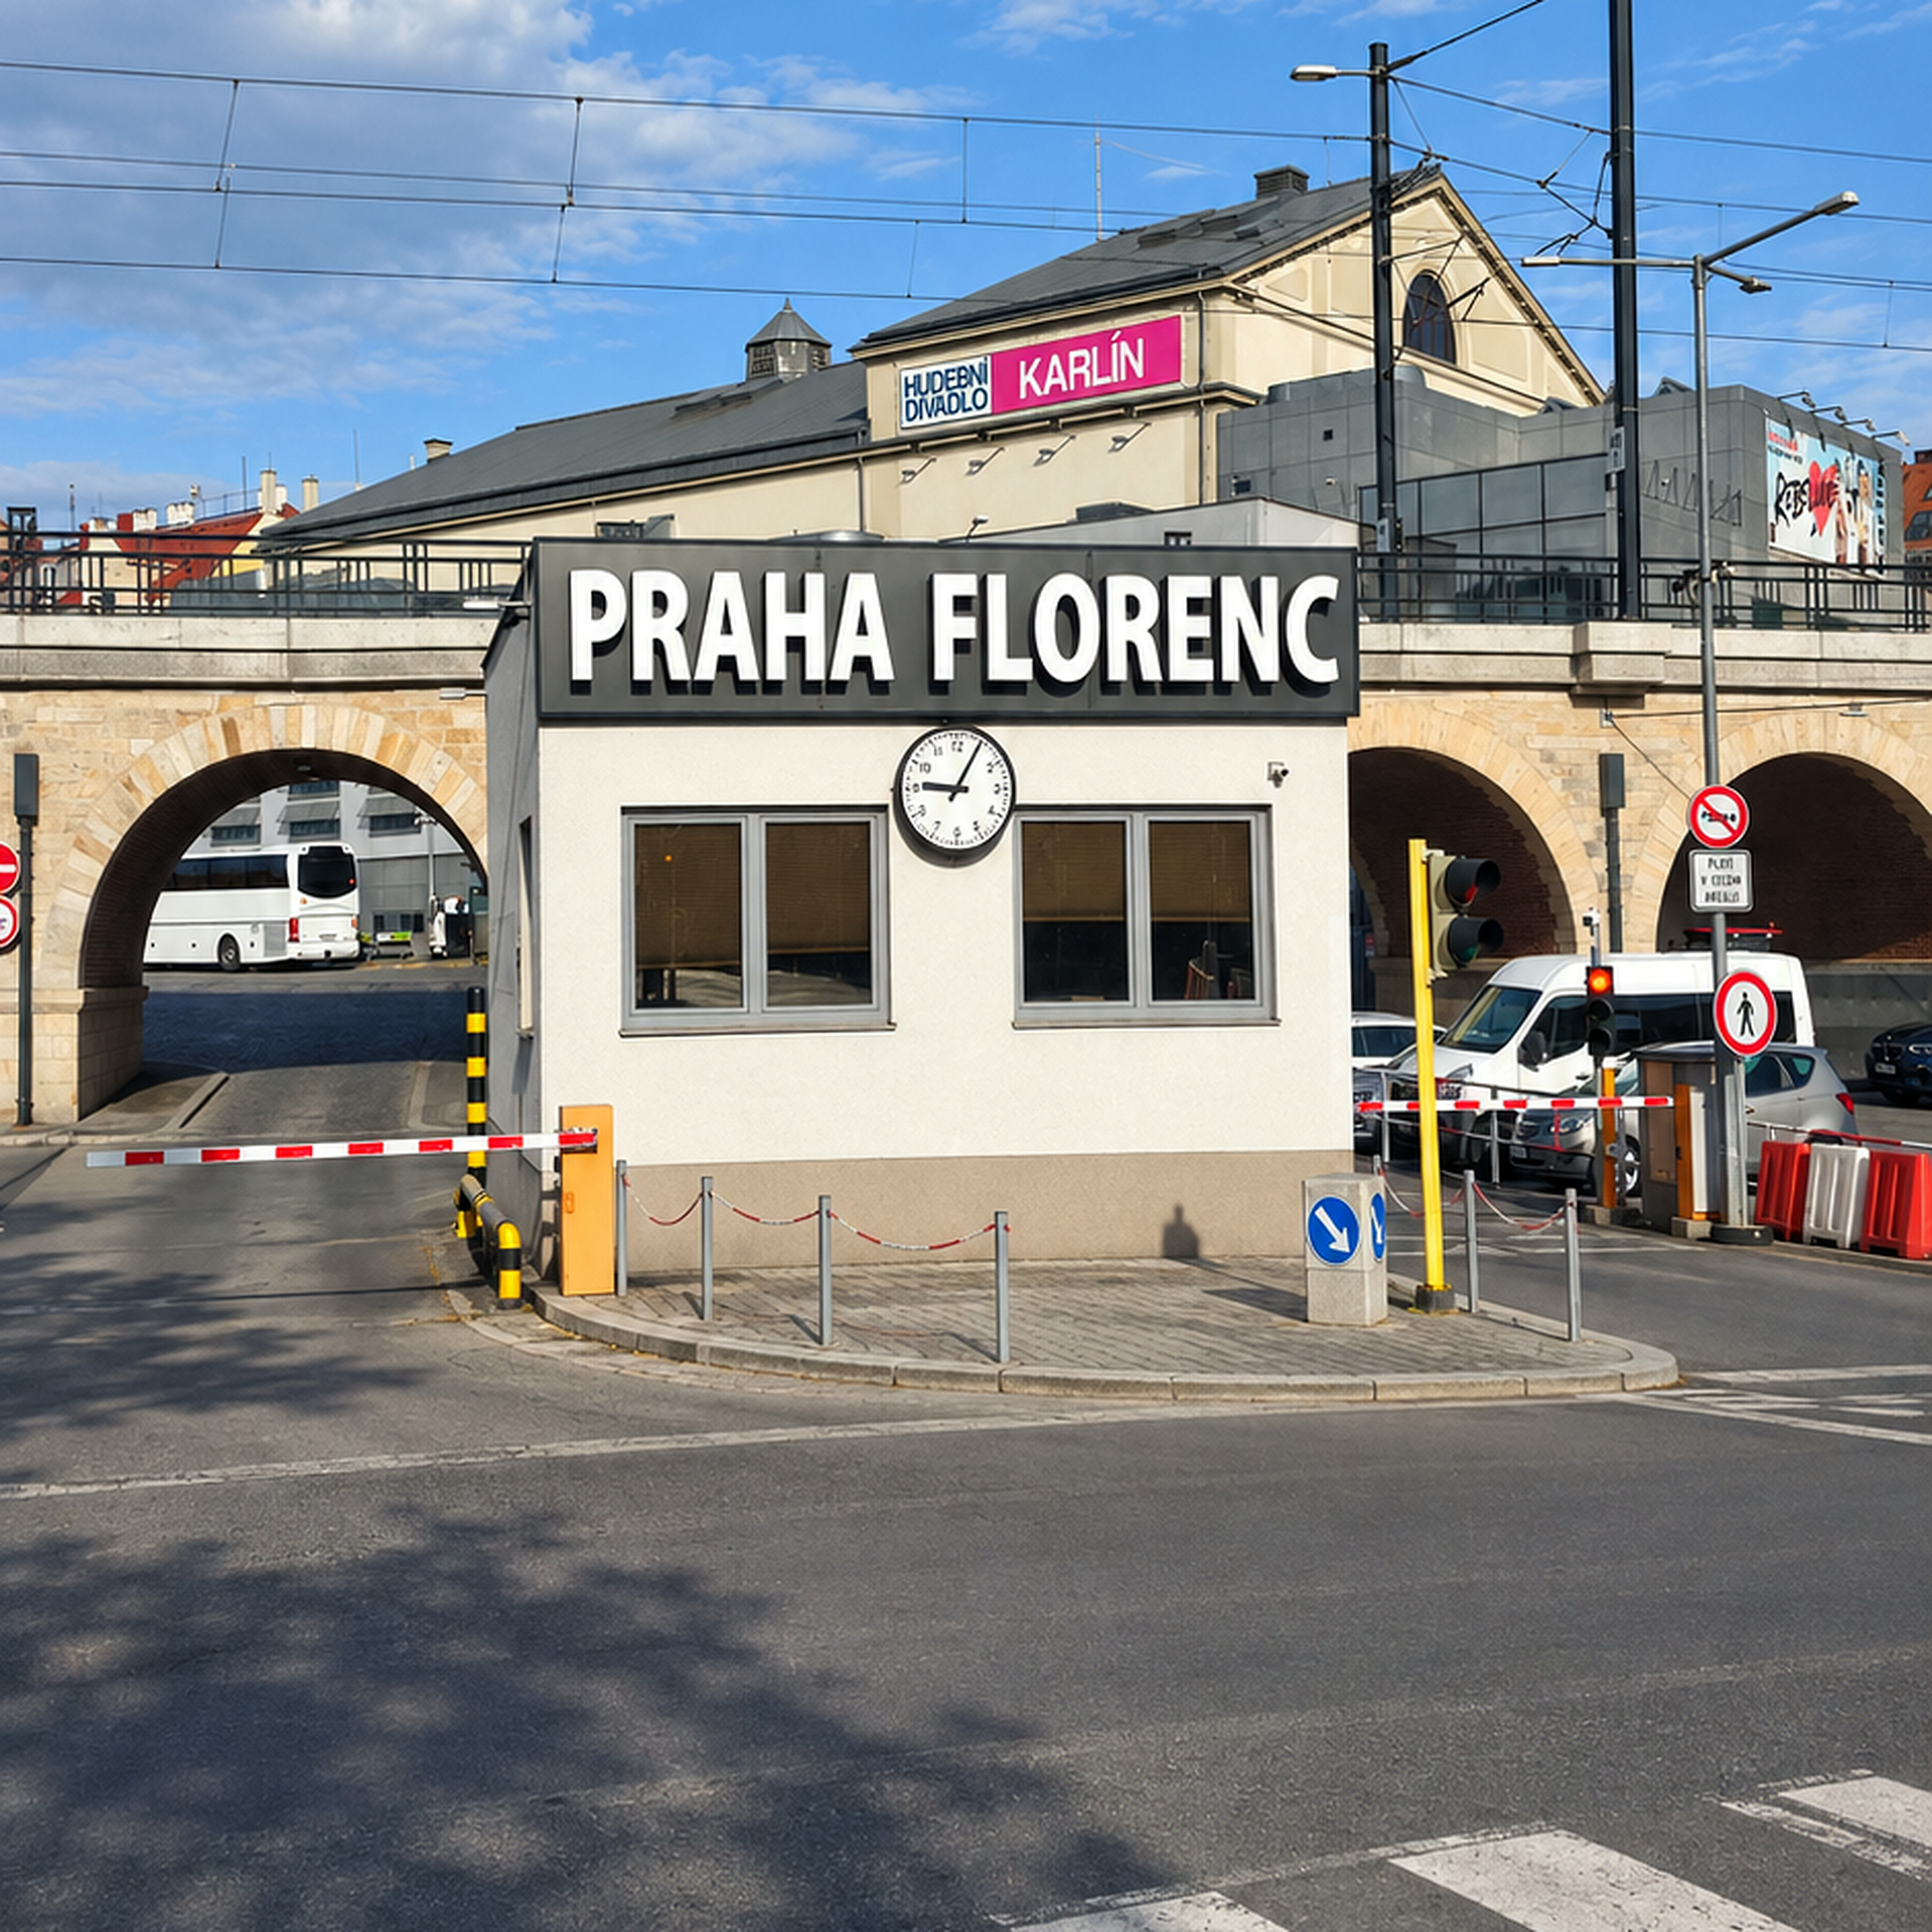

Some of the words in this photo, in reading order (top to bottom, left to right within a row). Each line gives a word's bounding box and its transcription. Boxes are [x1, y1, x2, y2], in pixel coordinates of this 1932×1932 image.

[905, 356, 987, 397] HUDEBNÍ
[1019, 330, 1144, 400] KARLÍN
[905, 388, 988, 422] DIVADLO
[569, 569, 896, 682] PRAHA
[931, 572, 1340, 683] FLORENC
[919, 762, 932, 774] 10
